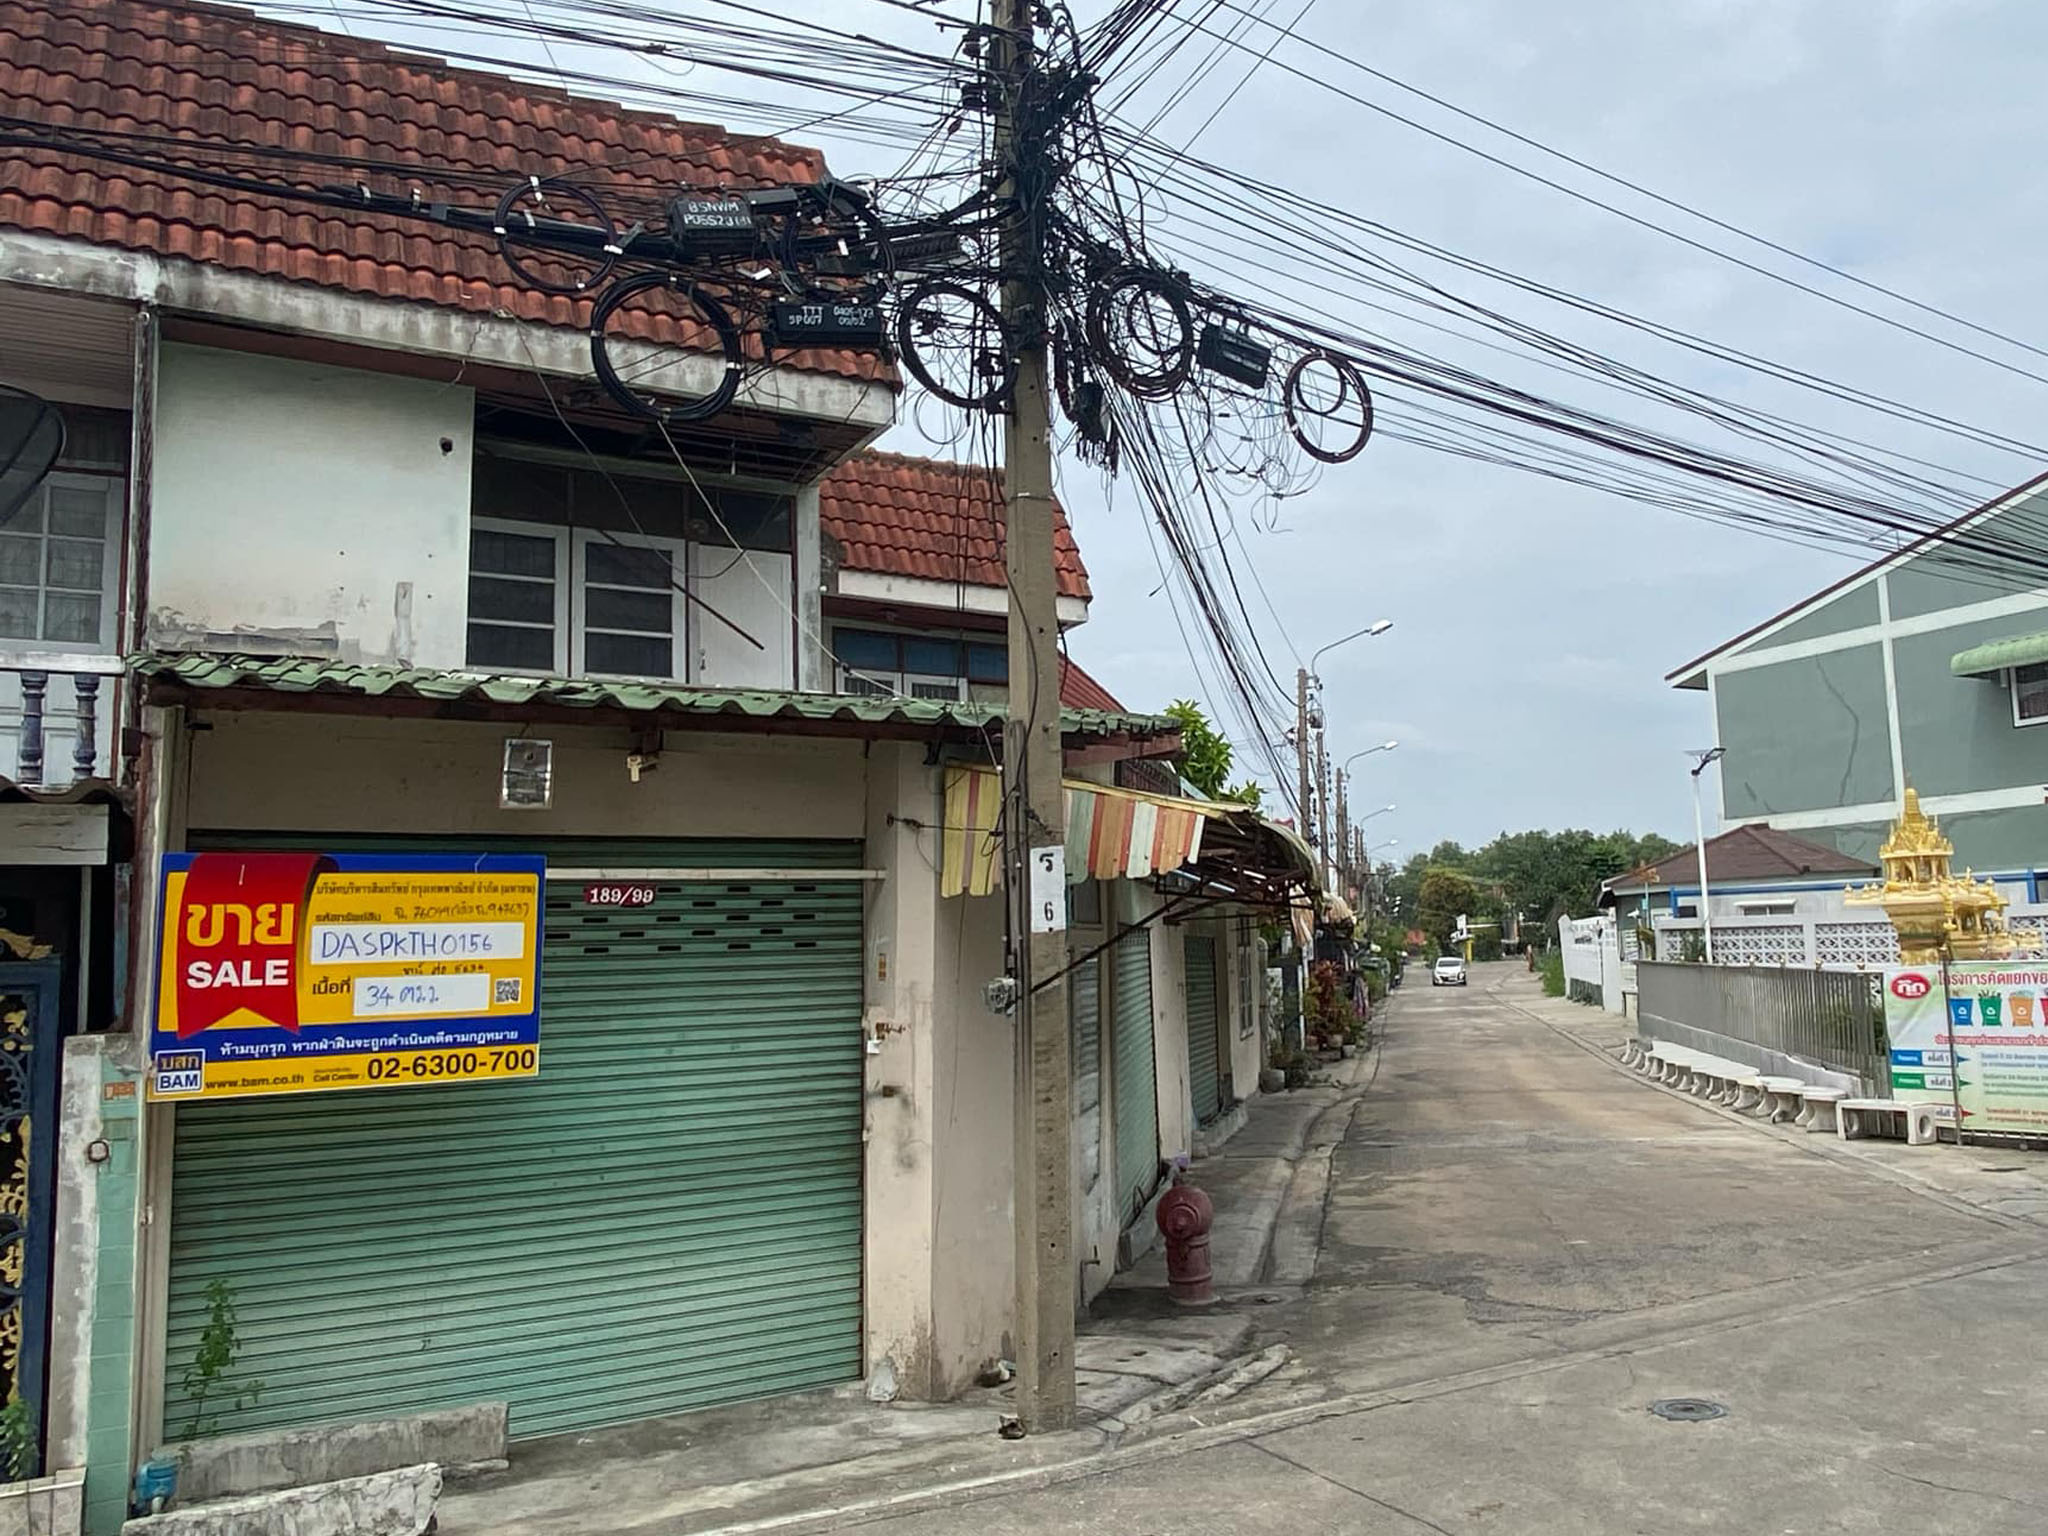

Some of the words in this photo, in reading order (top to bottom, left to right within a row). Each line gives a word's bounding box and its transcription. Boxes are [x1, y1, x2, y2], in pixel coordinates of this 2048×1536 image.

[589, 886, 654, 906] 189/99
[1043, 901, 1054, 921] 6
[186, 902, 294, 947] ขาย
[186, 958, 291, 990] SALE
[312, 975, 351, 996] เนื้อที่
[220, 1041, 287, 1058] ห้ามบุกรุก
[367, 1048, 536, 1080] 02-6300-700
[160, 1073, 198, 1089] BAM
[205, 1073, 305, 1089] www.bam.co.th
